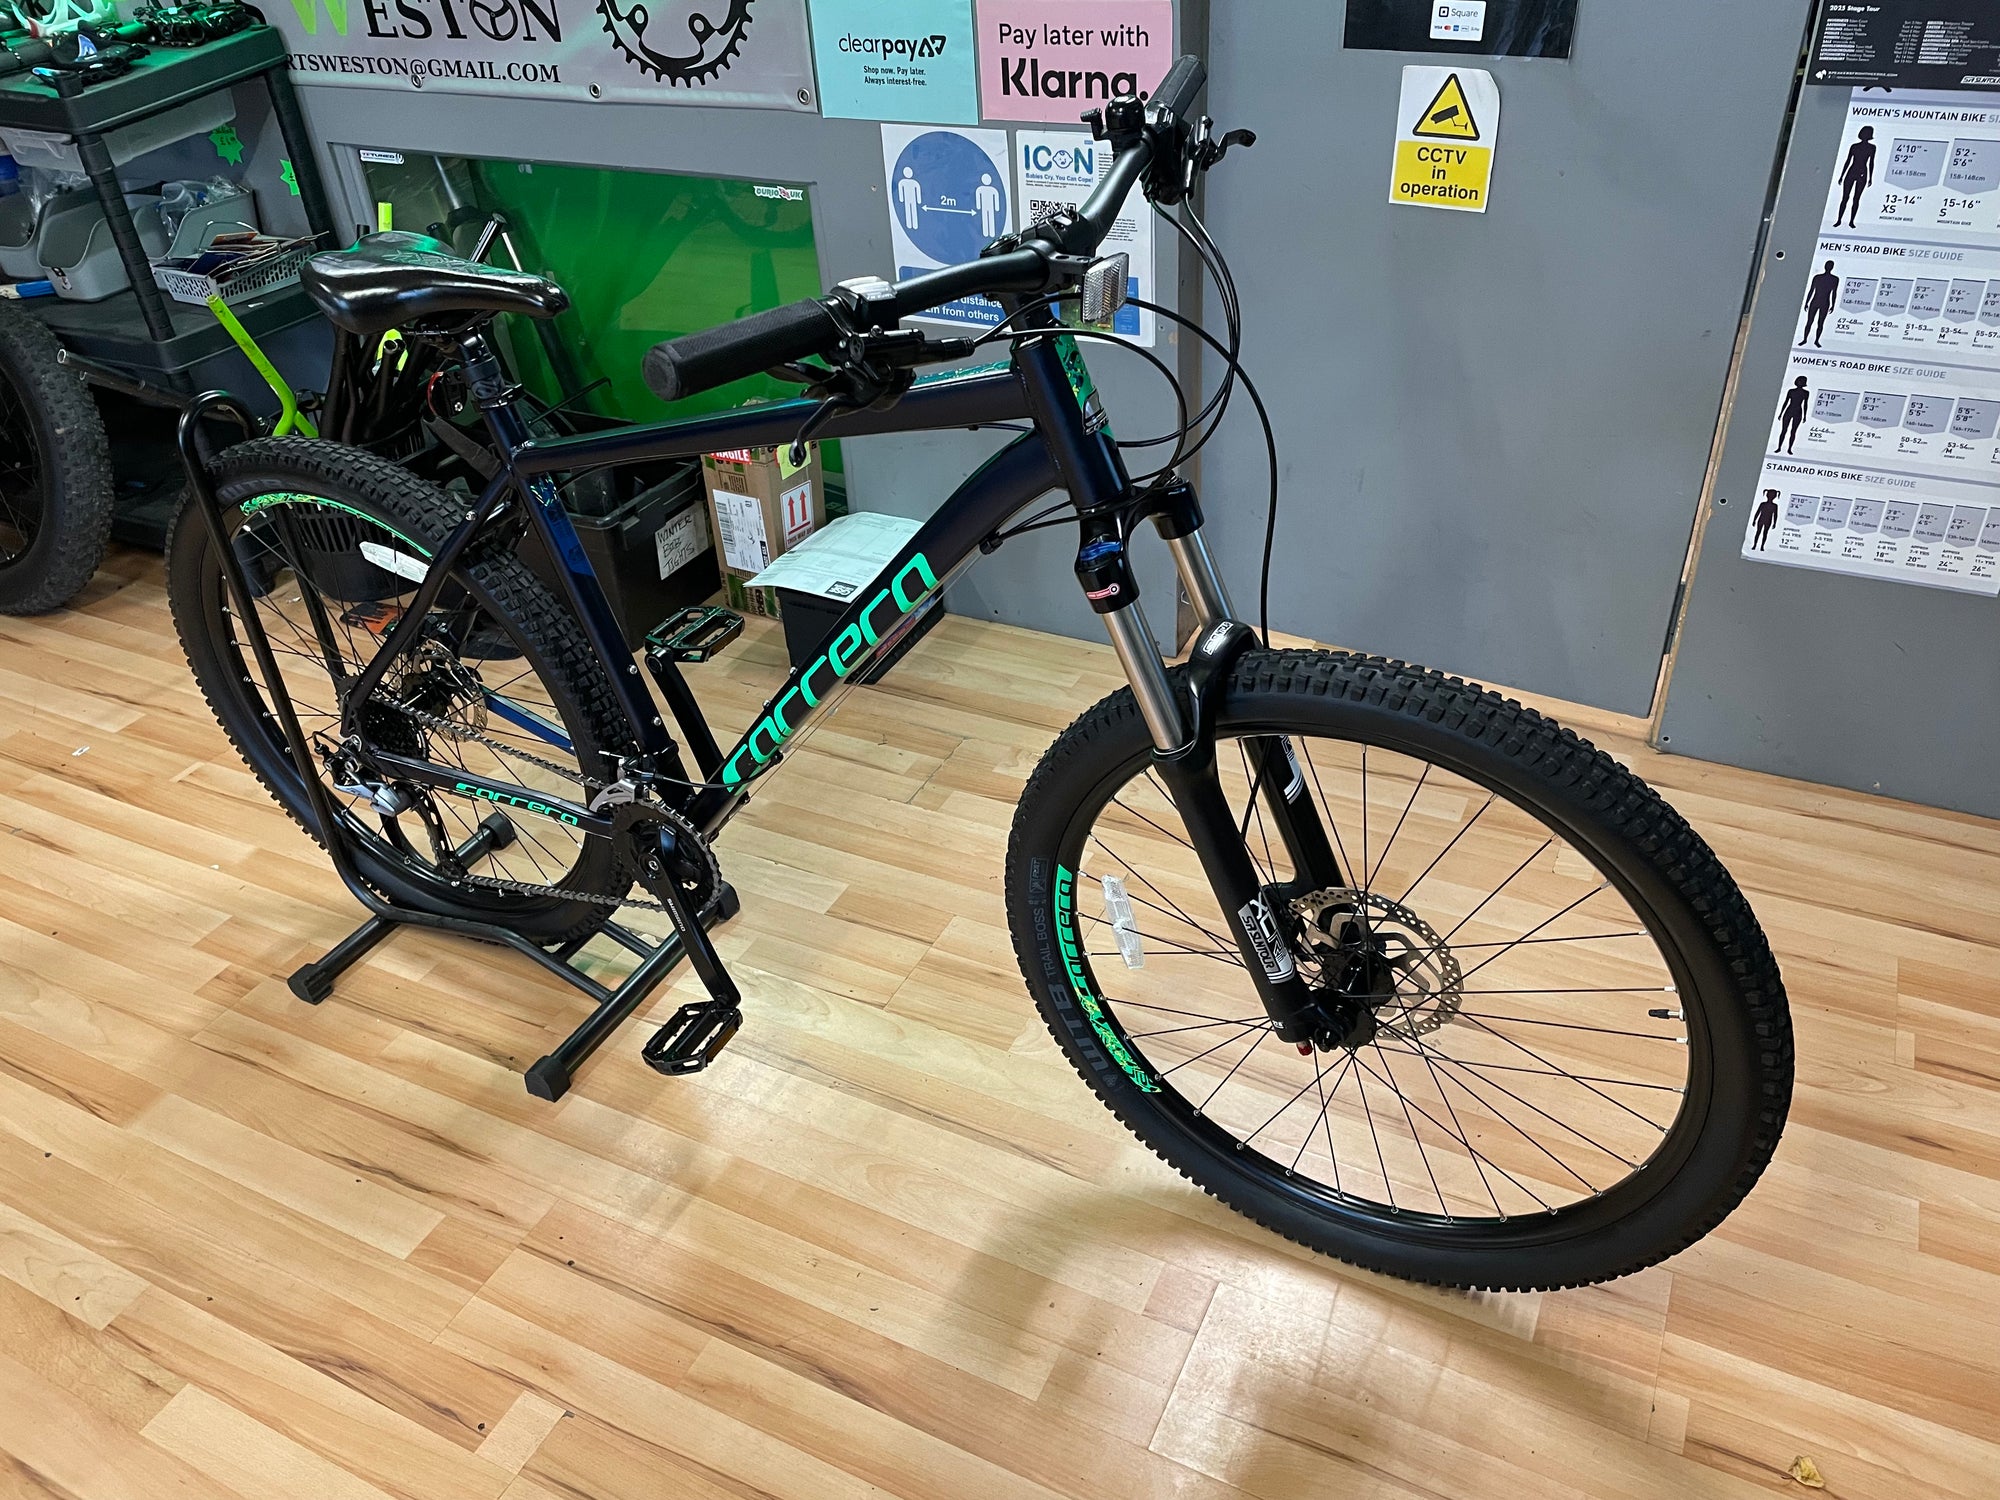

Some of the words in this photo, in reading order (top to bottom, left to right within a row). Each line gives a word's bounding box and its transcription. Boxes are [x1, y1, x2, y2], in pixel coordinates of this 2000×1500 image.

[1451, 8, 1479, 18] Square
[1847, 5, 1865, 13] Stage
[999, 24, 1036, 50] Pay
[1043, 24, 1094, 48] later
[1100, 25, 1149, 48] with
[838, 33, 918, 62] clearpay
[863, 65, 879, 75] Shop
[880, 67, 895, 75] now.
[896, 66, 908, 76] Pay
[909, 66, 926, 76] later.
[1000, 56, 1150, 102] Klarna.
[864, 76, 886, 86] Always
[886, 77, 927, 86] interest-free.
[1852, 107, 1900, 118] WOMEN'S
[1902, 110, 1958, 121] MOUNTAIN
[1961, 113, 1987, 122] BIKE
[1988, 115, 2000, 123] SI
[1024, 144, 1093, 175] ICON
[1417, 147, 1467, 165] CCTV
[1431, 165, 1447, 180] in
[1400, 181, 1479, 200] operation
[1885, 194, 1922, 205] 13-14"
[940, 195, 956, 206] 2m
[1881, 204, 1897, 214] XS
[1943, 198, 1981, 209] 15-16"
[1939, 208, 1947, 217] S
[1820, 242, 1851, 252] MEN'S
[1853, 244, 1881, 254] ROAD
[1882, 246, 1906, 256] BIKE
[1908, 249, 1931, 258] SIZE
[1932, 251, 1964, 261] GUIDE
[960, 296, 1003, 309] distance
[942, 305, 966, 318] from
[967, 309, 1000, 322] others
[1792, 356, 1838, 368] WOMEN'S
[1839, 360, 1865, 371] ROAD
[1868, 363, 1891, 373] BIKE
[1893, 366, 1914, 376] SIZE
[1916, 369, 1947, 379] GUIDE
[1766, 462, 1816, 476] STANDARD
[1817, 467, 1840, 478] KIDS
[1841, 470, 1864, 482] BIKE
[1864, 474, 1886, 485] SIZE
[1887, 476, 1917, 489] GUIDE
[722, 552, 939, 796] carrera
[456, 782, 579, 826] carrera
[667, 898, 686, 932] SHIMANO
[1034, 907, 1048, 941] BOSS
[1058, 878, 1091, 999] carrera
[1249, 930, 1276, 970] SUNTOUR
[1039, 943, 1056, 977] TRAIL
[1048, 983, 1109, 1072] WTB
